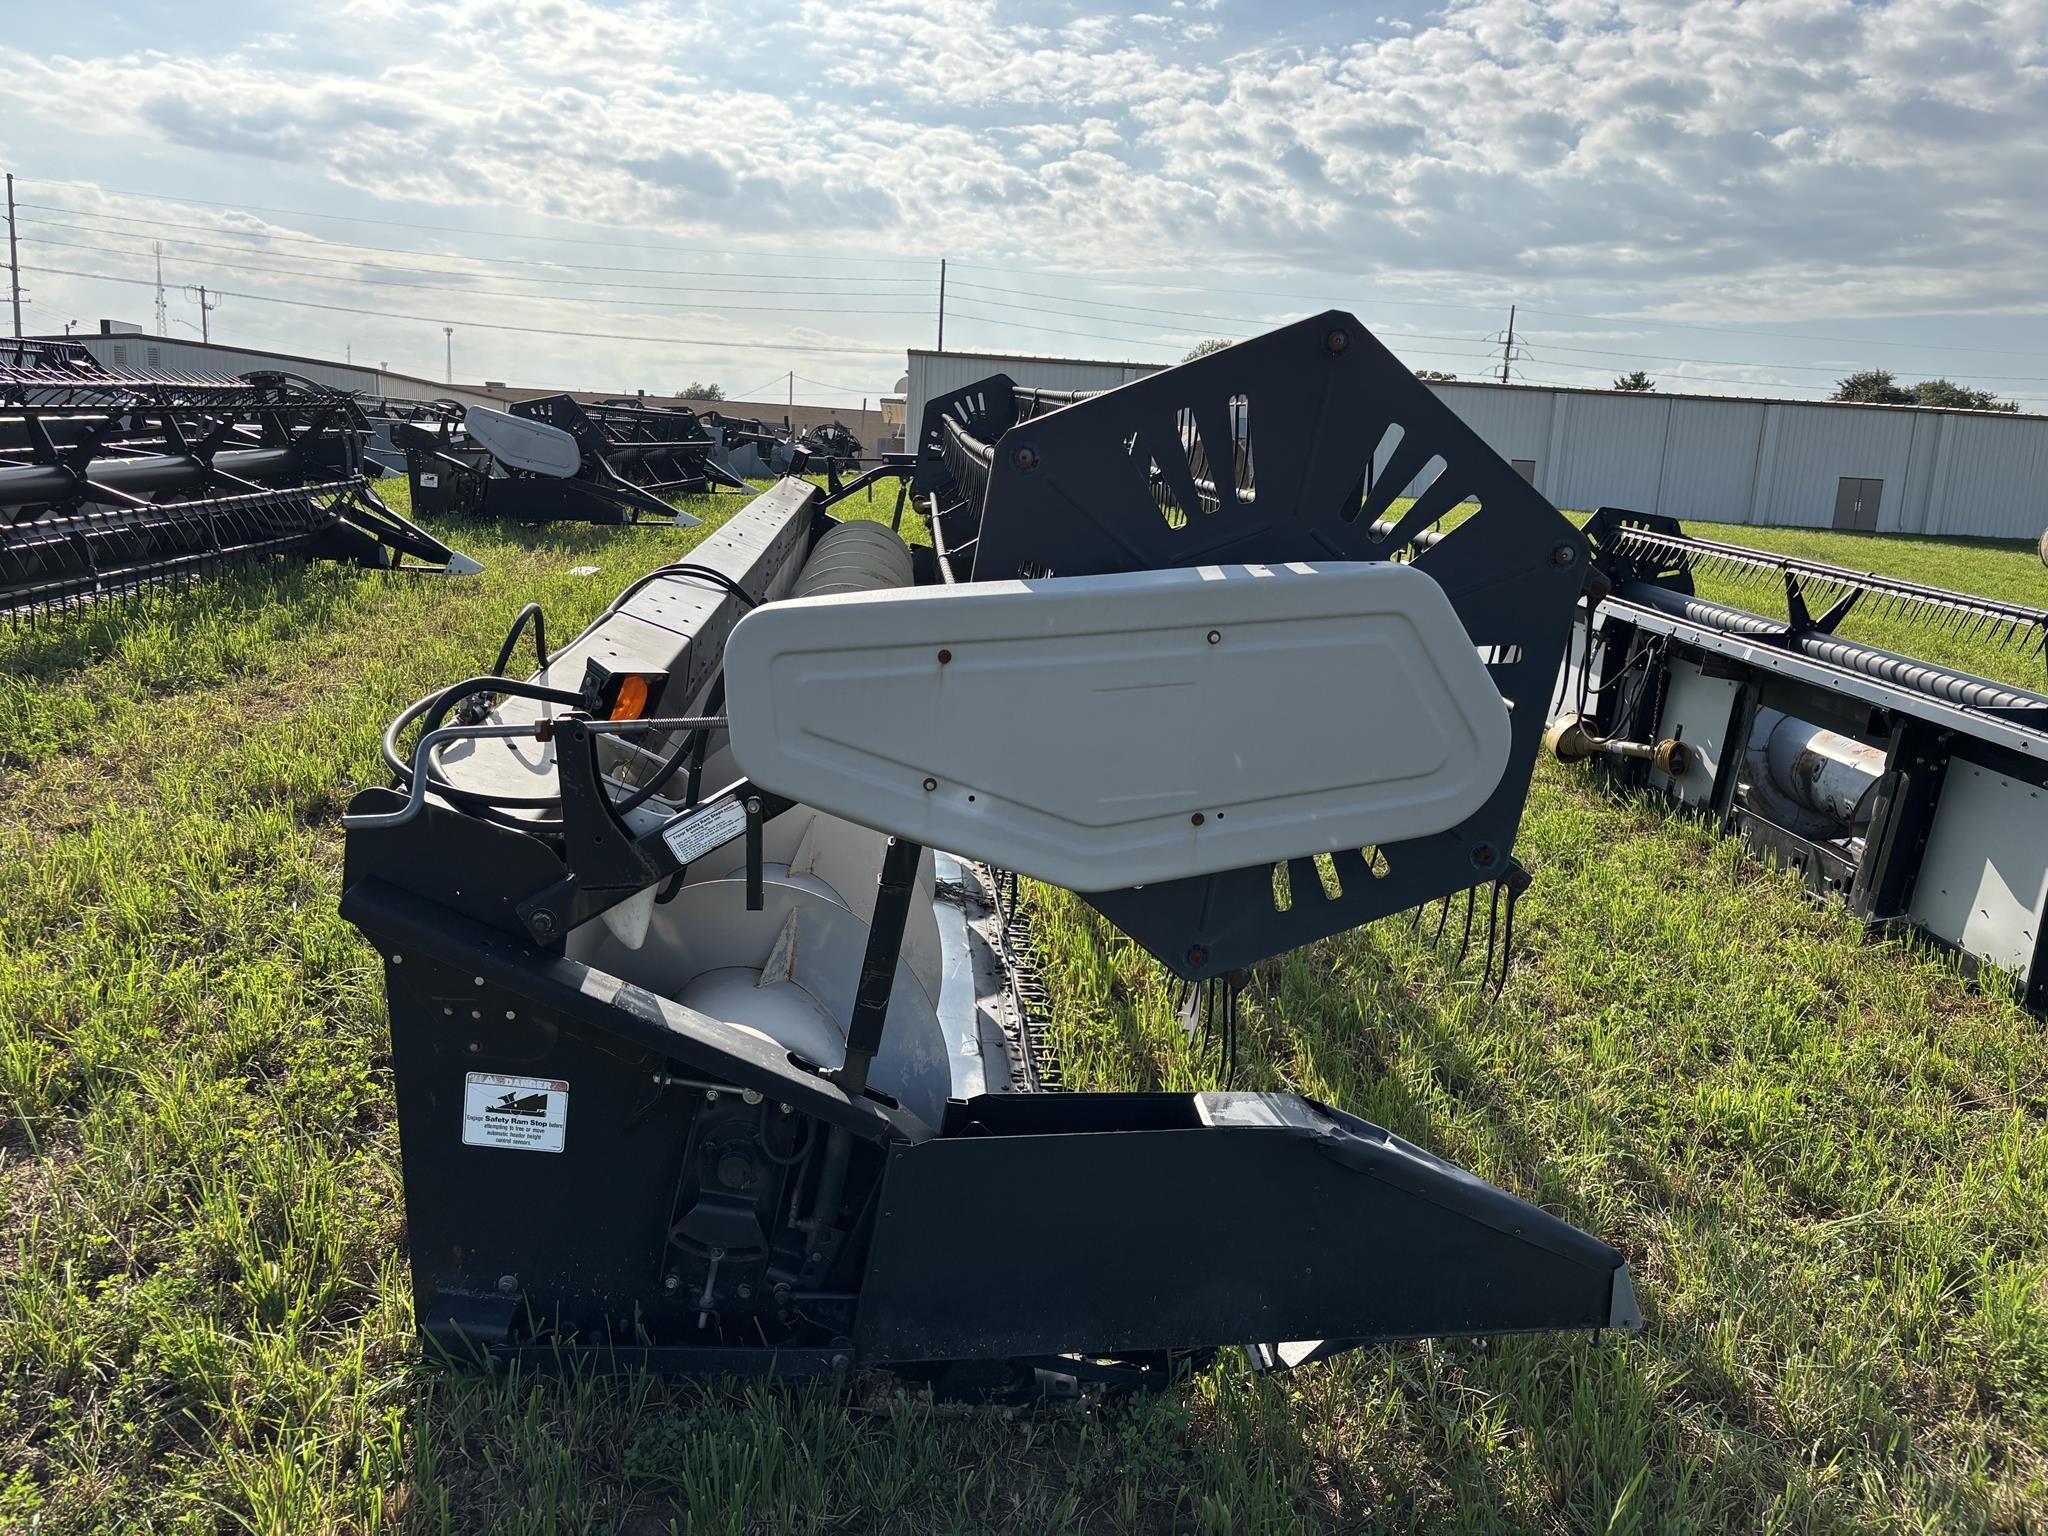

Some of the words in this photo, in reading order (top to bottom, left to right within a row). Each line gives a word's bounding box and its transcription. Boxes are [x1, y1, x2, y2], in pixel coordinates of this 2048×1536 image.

[685, 822, 700, 832] Safety
[504, 1077, 552, 1090] DANGER
[485, 1115, 510, 1124] Safety
[511, 1118, 528, 1126] Ram
[530, 1119, 548, 1128] Stop
